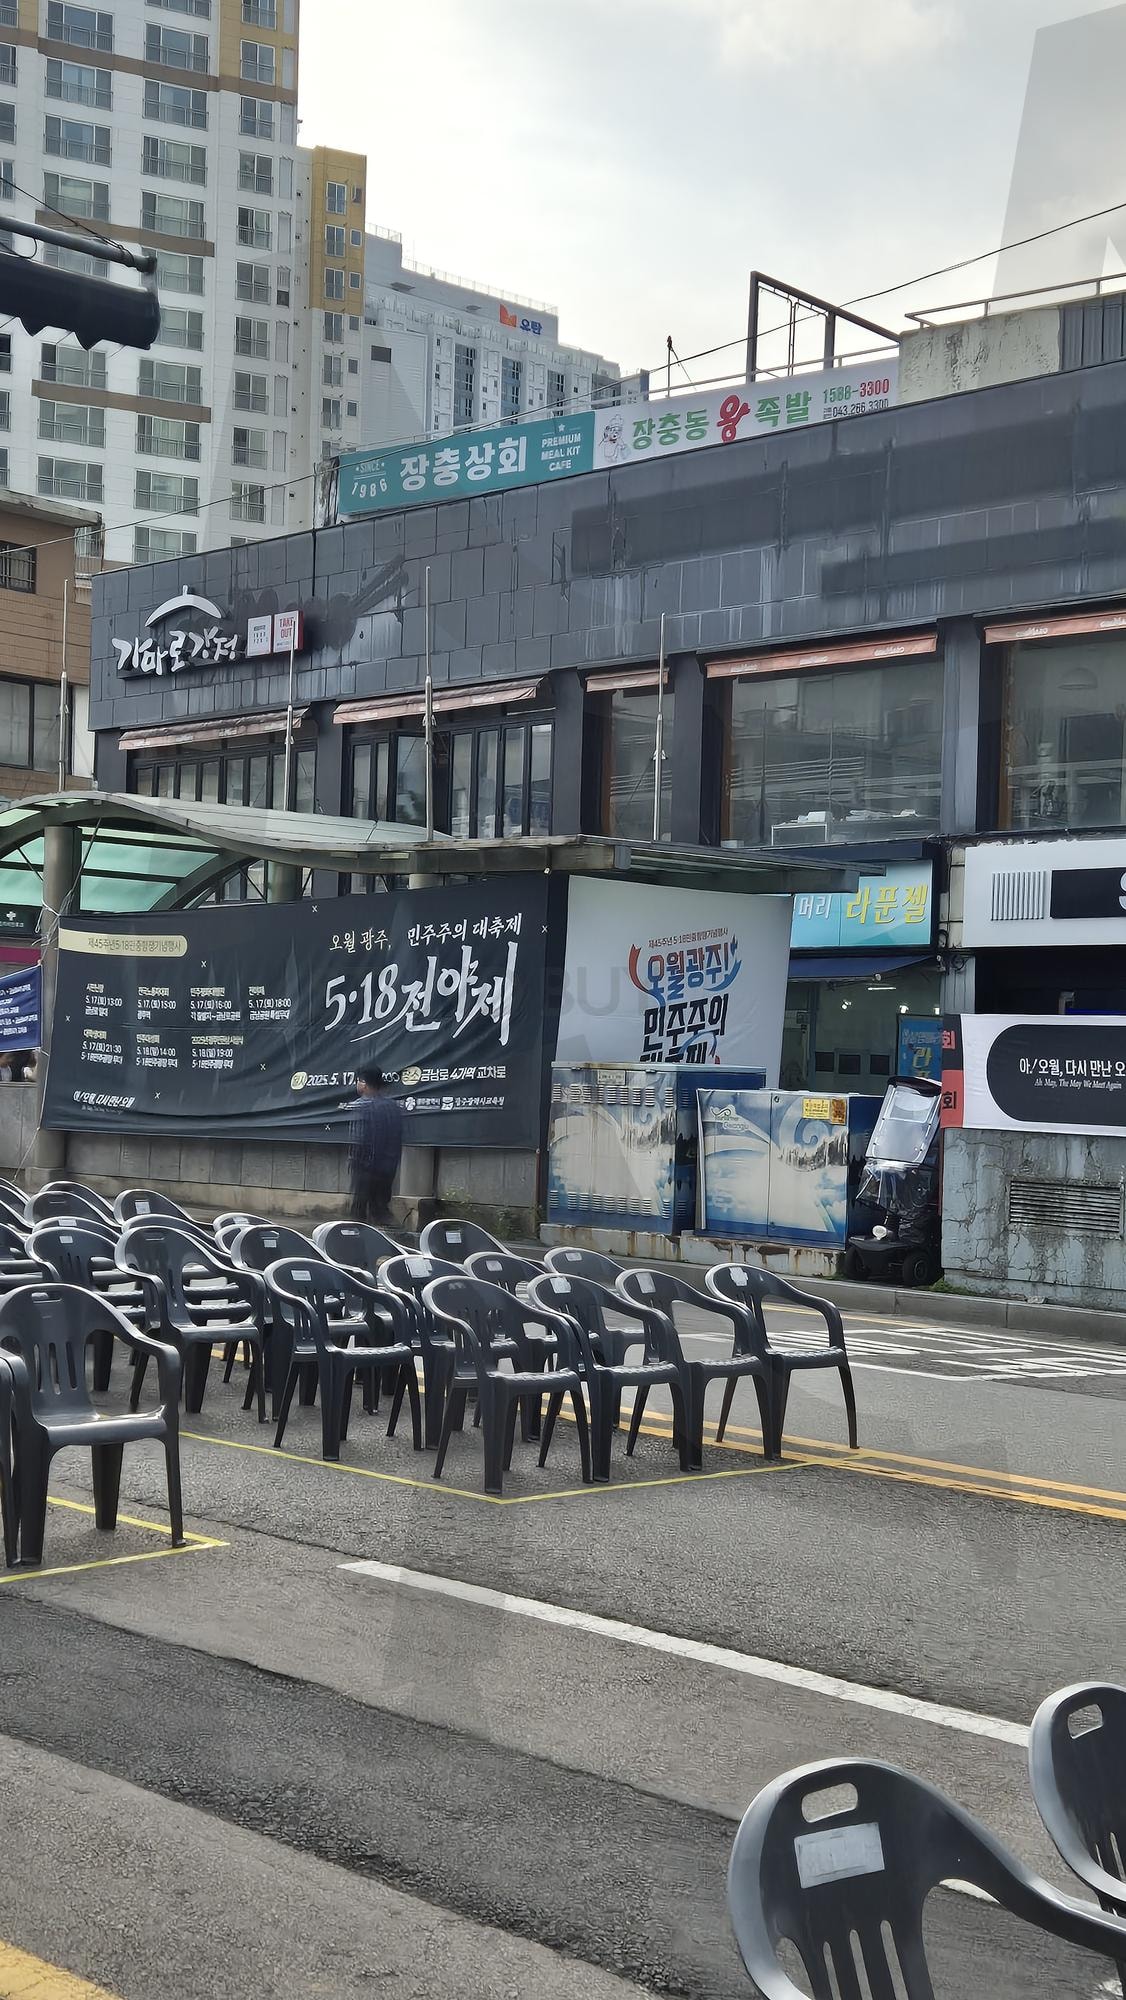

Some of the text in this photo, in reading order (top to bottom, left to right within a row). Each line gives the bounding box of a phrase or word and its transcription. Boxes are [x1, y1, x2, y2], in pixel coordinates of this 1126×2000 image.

[823, 379, 889, 404] 1588-3300
[541, 433, 581, 448] PREMIUM
[541, 446, 581, 460] MEAL KIT
[400, 436, 528, 491] 장충상회
[549, 460, 572, 471] CAFE
[352, 479, 387, 498] 1986
[280, 616, 294, 628] TAKE
[281, 628, 292, 638] OUT
[111, 626, 238, 675] 가마로강정
[846, 884, 928, 924] 라푼젤
[329, 912, 522, 953] 오월 광주, 민주주의 대축제
[643, 993, 729, 1053] 민주주의
[421, 1068, 449, 1082] 금남로
[477, 1065, 506, 1079] 교차로
[1038, 1059, 1063, 1077] 오월,
[1065, 1059, 1087, 1077] 다시
[1089, 1059, 1113, 1078] 만난
